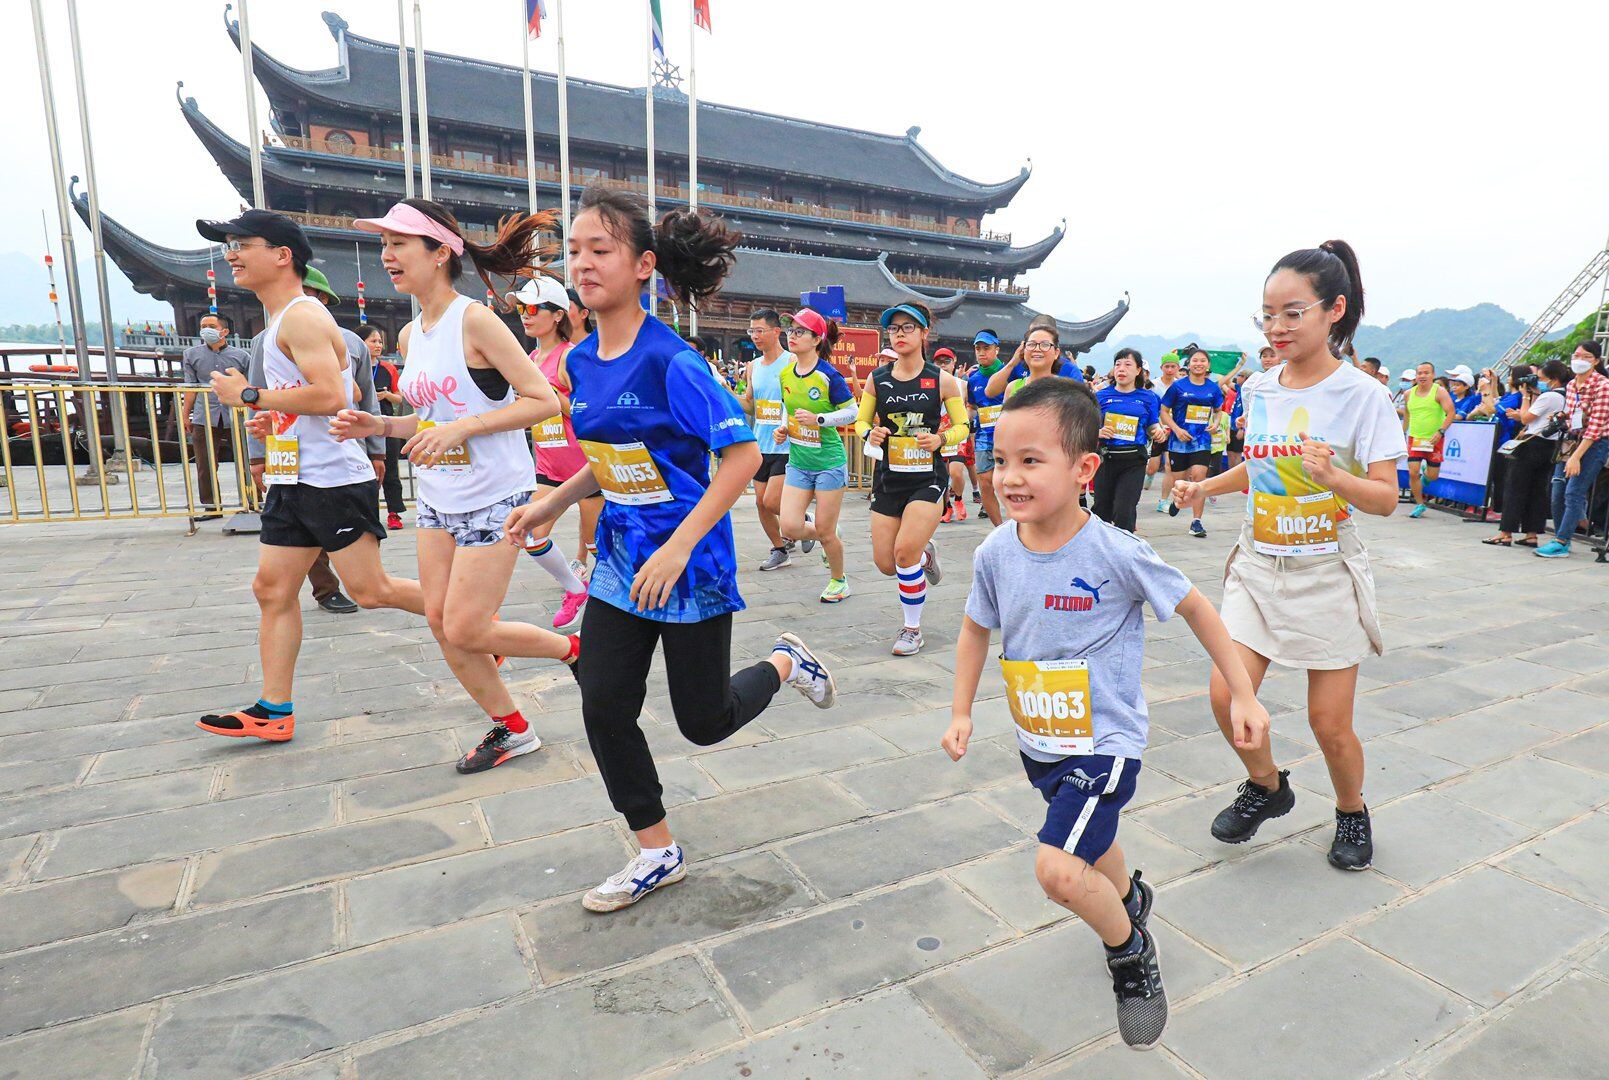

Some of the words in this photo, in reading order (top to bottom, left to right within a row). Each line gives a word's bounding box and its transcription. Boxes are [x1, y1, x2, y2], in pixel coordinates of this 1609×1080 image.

[847, 342, 856, 351] RA
[886, 392, 929, 404] ANTA
[800, 424, 819, 439] 10211
[268, 451, 298, 467] 10125
[609, 462, 658, 484] 10153
[1275, 513, 1333, 535] 10024
[1016, 691, 1086, 720] 10063
